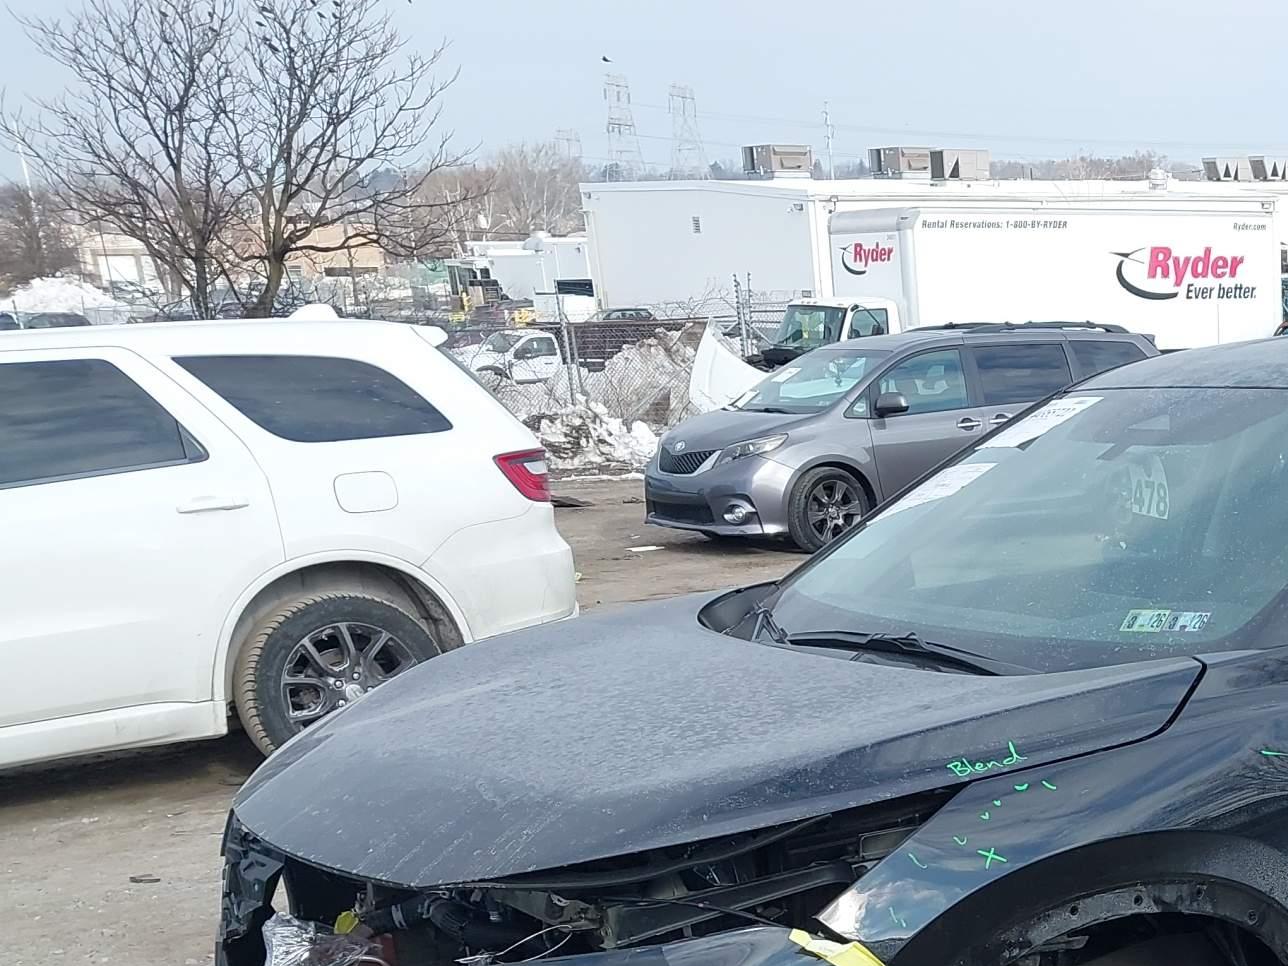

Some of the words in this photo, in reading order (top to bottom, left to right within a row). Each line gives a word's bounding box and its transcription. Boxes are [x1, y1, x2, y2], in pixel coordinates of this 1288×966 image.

[921, 219, 948, 229] Rental
[949, 219, 1003, 230] Reservations:
[853, 241, 894, 268] Ryder
[1147, 246, 1245, 288] Ryder
[1186, 283, 1215, 300] Ever
[1217, 283, 1257, 300] better.
[1133, 480, 1168, 517] 478
[946, 740, 1028, 776] Blend
